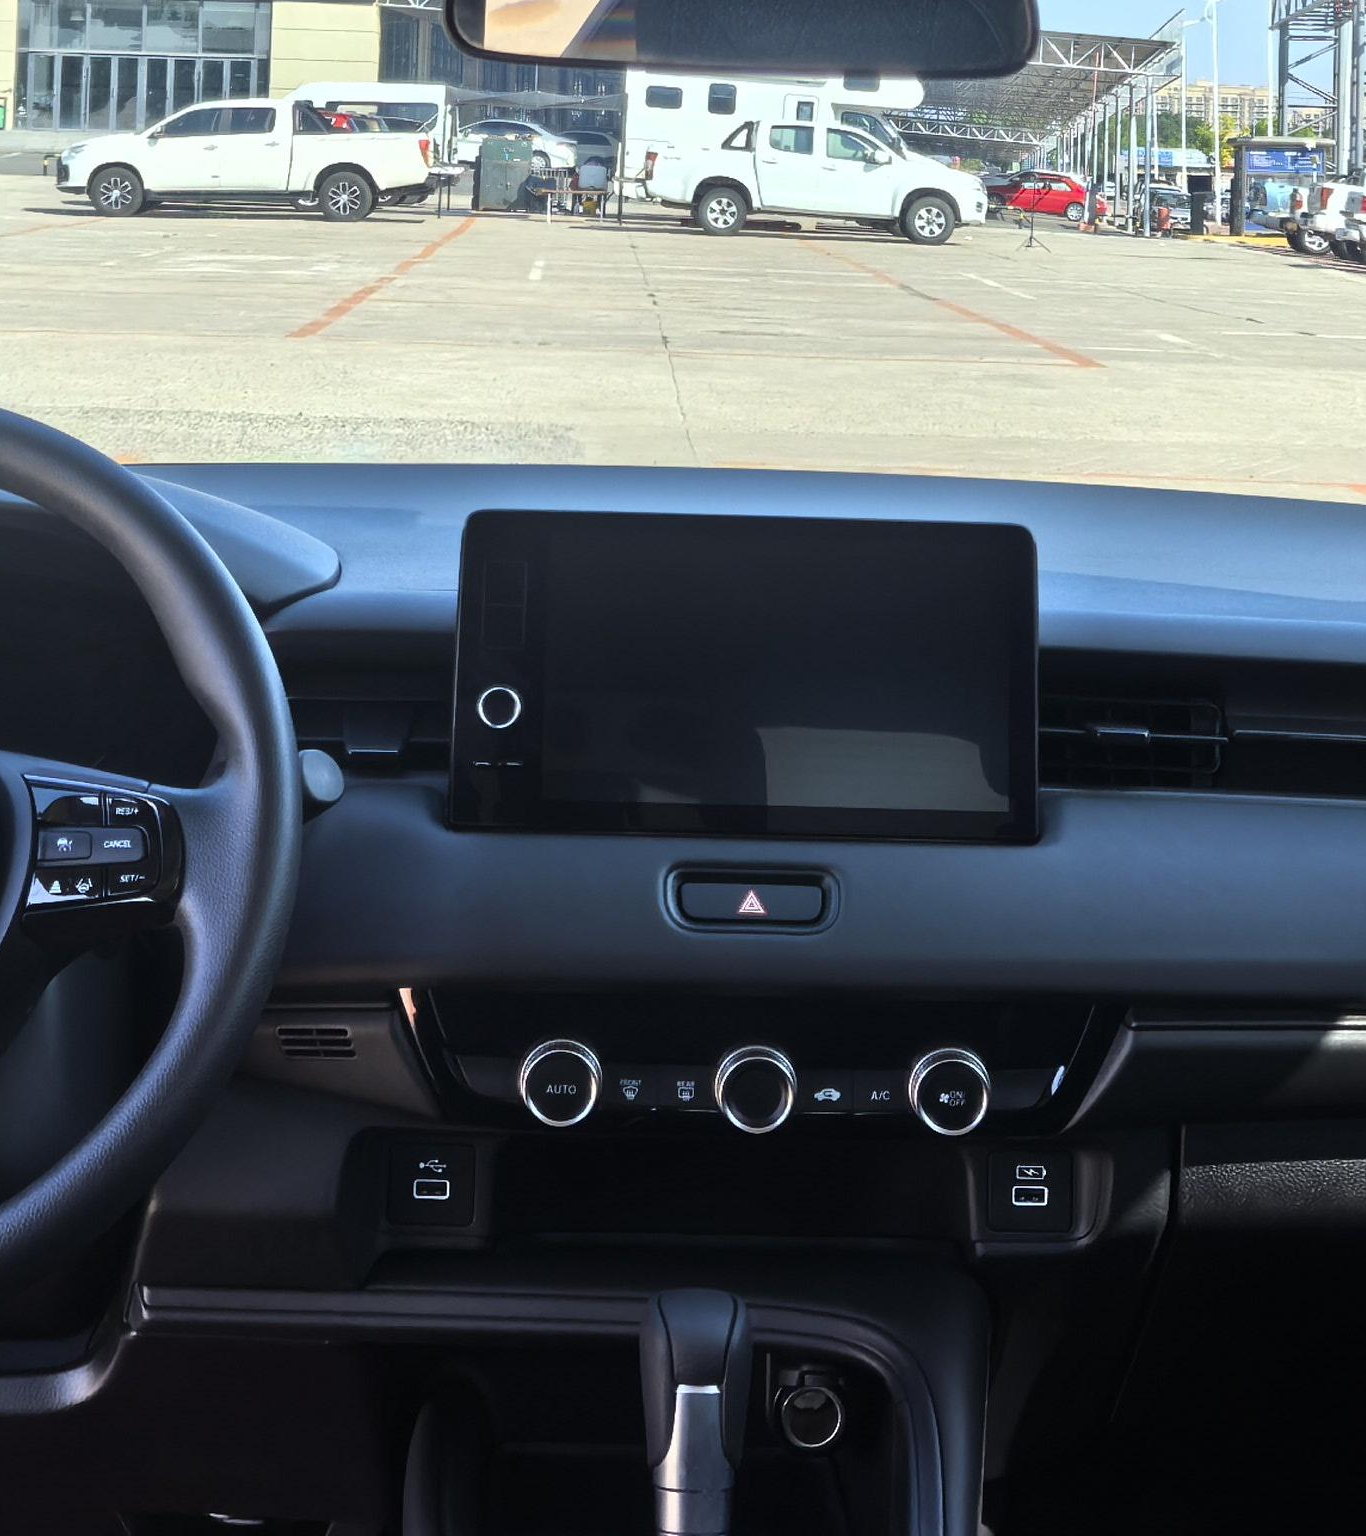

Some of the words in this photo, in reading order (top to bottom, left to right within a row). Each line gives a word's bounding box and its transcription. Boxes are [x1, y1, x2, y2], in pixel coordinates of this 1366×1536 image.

[103, 840, 131, 848] CANCEL
[546, 1084, 577, 1095] AUTO
[871, 1090, 891, 1101] A/C
